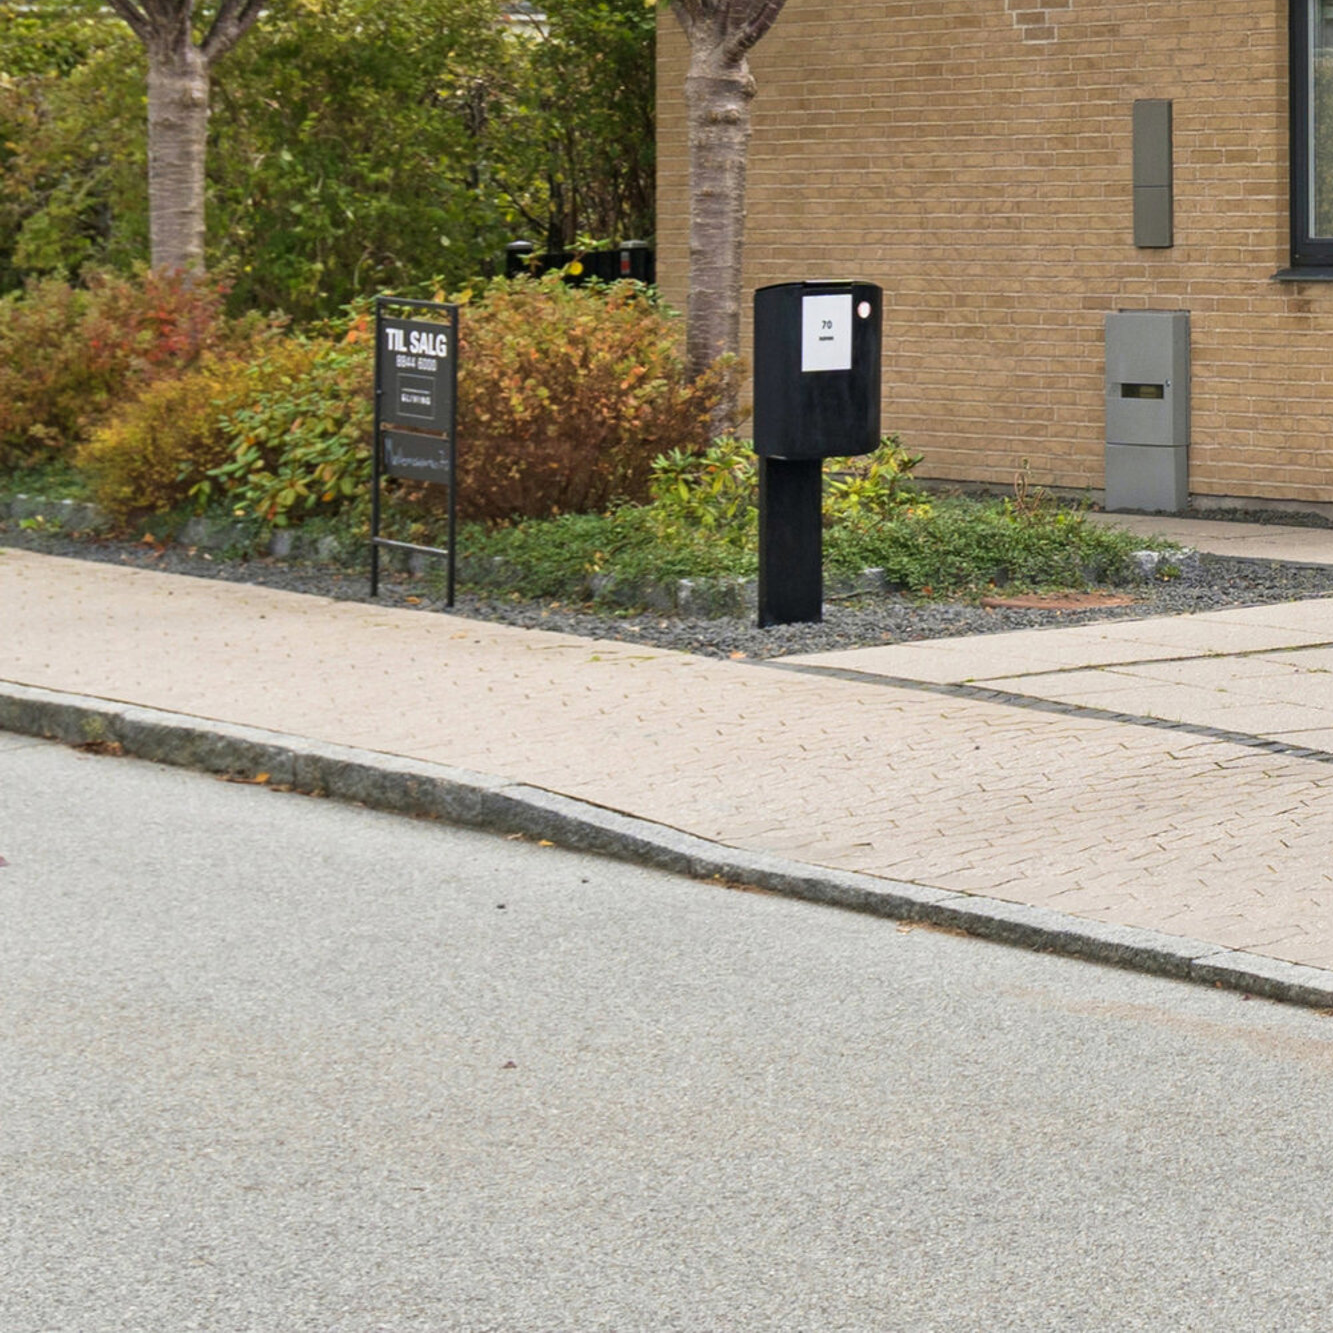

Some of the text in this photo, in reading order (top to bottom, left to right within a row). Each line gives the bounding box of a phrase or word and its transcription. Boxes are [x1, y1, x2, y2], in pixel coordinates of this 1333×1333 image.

[821, 319, 833, 330] 70
[385, 327, 448, 358] TIL SALG
